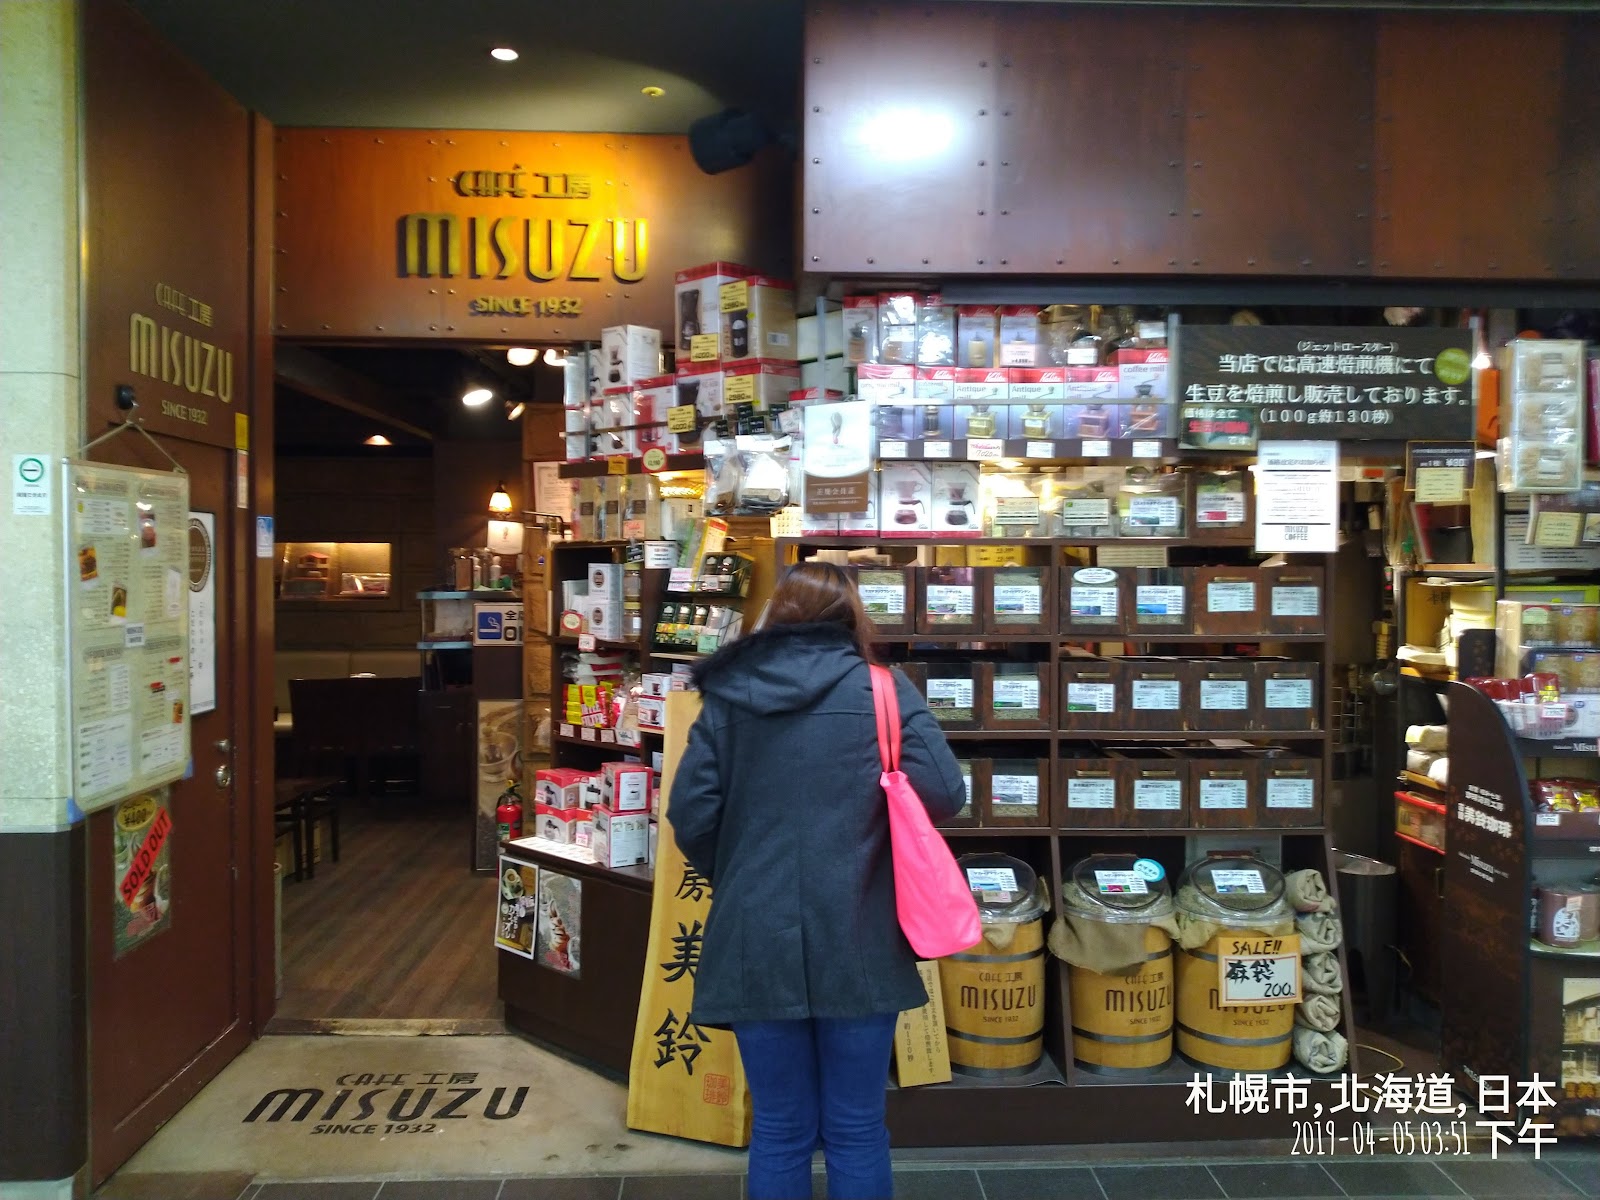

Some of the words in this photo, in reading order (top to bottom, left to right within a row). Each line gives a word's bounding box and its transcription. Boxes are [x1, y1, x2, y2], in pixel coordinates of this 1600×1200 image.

[534, 173, 592, 198] 工房
[402, 213, 648, 282] MISUZU
[188, 297, 214, 328] 工房
[473, 296, 530, 314] SINCE
[538, 297, 582, 315] 1932
[129, 312, 233, 404] MISUZU
[1218, 353, 1434, 375] 当店では高速焙煎機にて
[956, 385, 987, 393] Antique
[1011, 385, 1042, 393] Antique
[1184, 382, 1469, 405] 生豆を焙煎し販売しております。
[161, 400, 187, 420] SINCE
[188, 404, 208, 425] 1932
[1284, 533, 1309, 541] COFFEE
[123, 850, 151, 901] SOLD
[148, 809, 170, 852] OUT
[1232, 939, 1283, 956] SALE!!
[1226, 959, 1276, 984] 麻袋
[960, 984, 1036, 1011] MISUZU
[1129, 1016, 1148, 1025] SINCE
[1149, 1015, 1162, 1023] 1932
[1232, 1018, 1253, 1026] SINCE
[1254, 1018, 1270, 1026] 1932
[416, 1072, 480, 1085] 工房
[242, 1086, 531, 1123] MISUZU
[310, 1124, 376, 1135] SINCE
[382, 1123, 437, 1135] 1932
